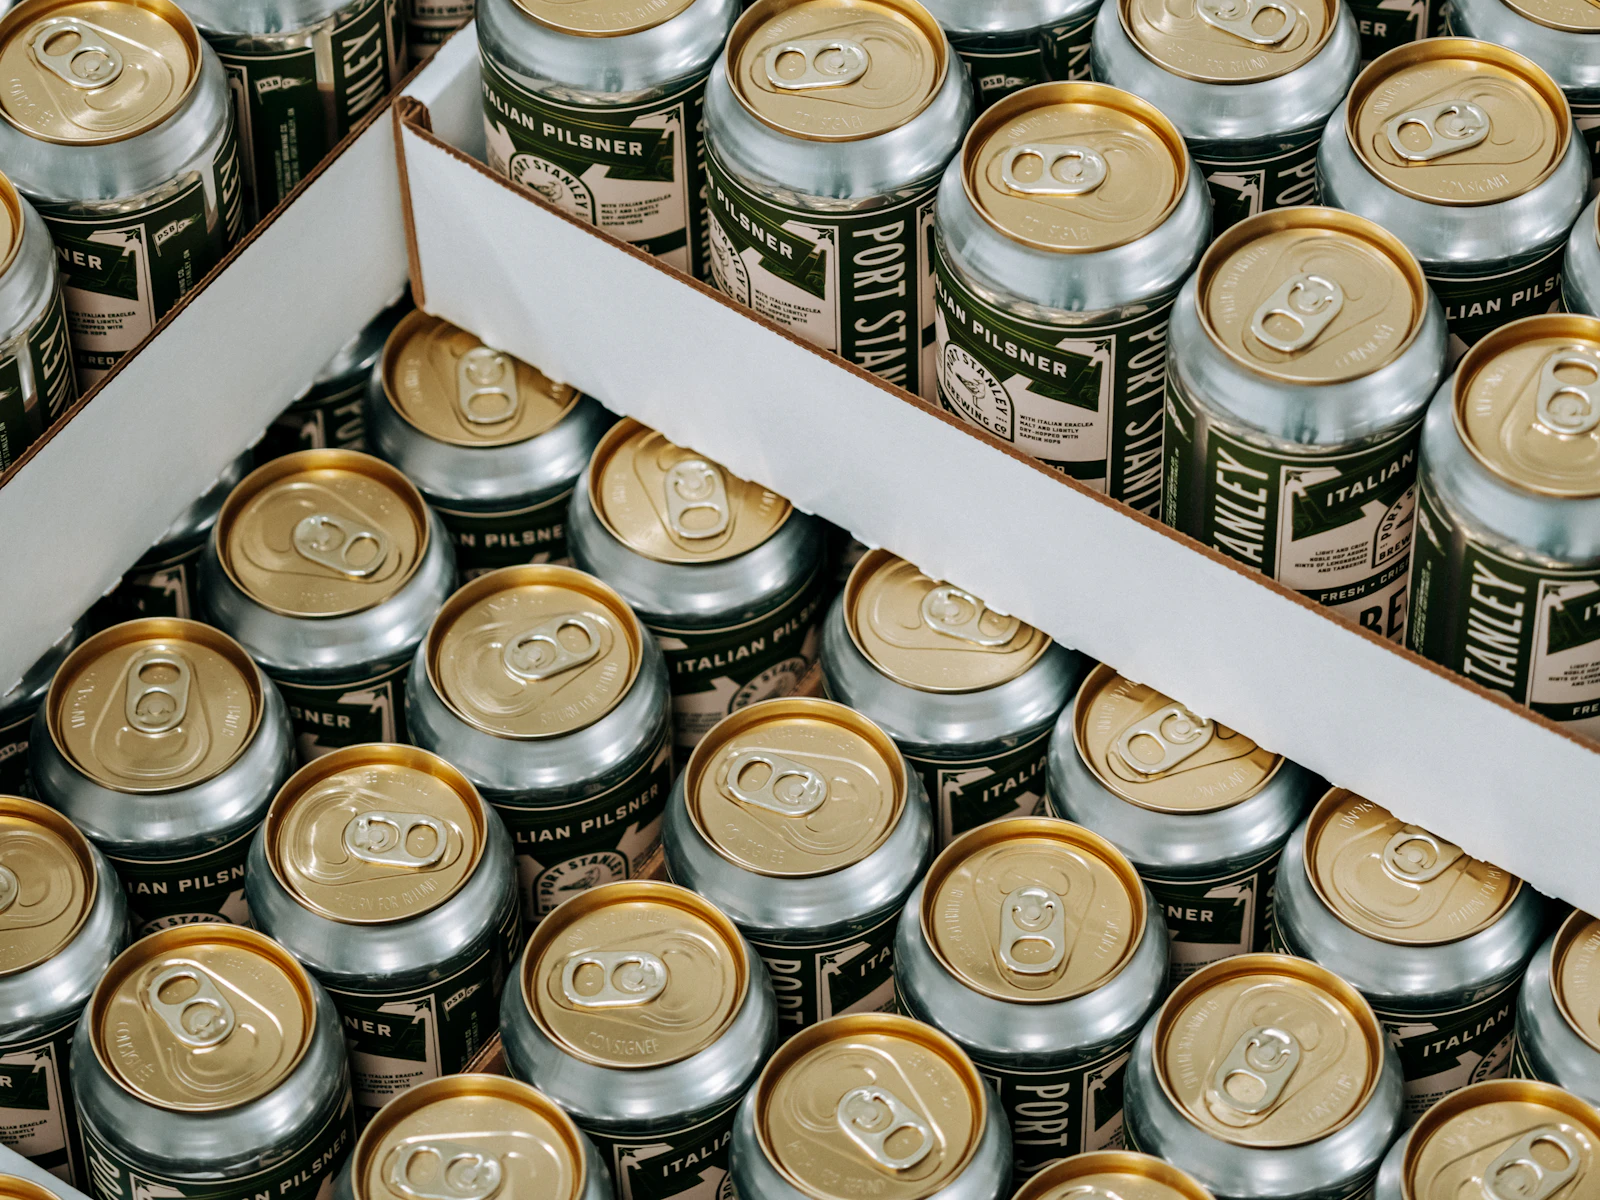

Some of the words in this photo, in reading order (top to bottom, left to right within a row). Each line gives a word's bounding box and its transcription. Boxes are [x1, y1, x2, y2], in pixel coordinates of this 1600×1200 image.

[481, 80, 534, 131] ITALIAN
[543, 121, 643, 157] PILSNER
[513, 157, 531, 185] PORT
[533, 159, 589, 210] STANLEY
[156, 225, 176, 242] PSB
[717, 189, 793, 261] PILSNER
[852, 219, 907, 302] PORT
[972, 319, 1068, 379] PILSNER
[946, 379, 990, 427] BREWING
[961, 352, 1009, 417] STANLEY
[1019, 414, 1036, 423] WITH
[1037, 417, 1063, 427] ITALIAN
[1019, 420, 1037, 430] MALT
[1019, 426, 1061, 439] DRY-HOPPED
[1019, 432, 1043, 442] SAPHIR
[1044, 437, 1061, 445] HOPS
[1326, 448, 1415, 507] ITALIAN
[1212, 446, 1269, 574] ANLEY
[1380, 502, 1404, 542] PORT
[1320, 583, 1365, 602] FRESH
[1462, 559, 1527, 690] TANLEY
[676, 637, 766, 675] ITALIAN
[516, 825, 571, 844] LIAN
[581, 783, 659, 834] PILSNER
[540, 868, 565, 896] PORT
[568, 853, 623, 877] STANLEY
[1159, 904, 1214, 922] NER
[445, 990, 465, 1010] PSB
[1423, 1004, 1510, 1058] ITALIAN
[1015, 1082, 1070, 1147] PORT
[279, 1128, 349, 1195] PILSNER
